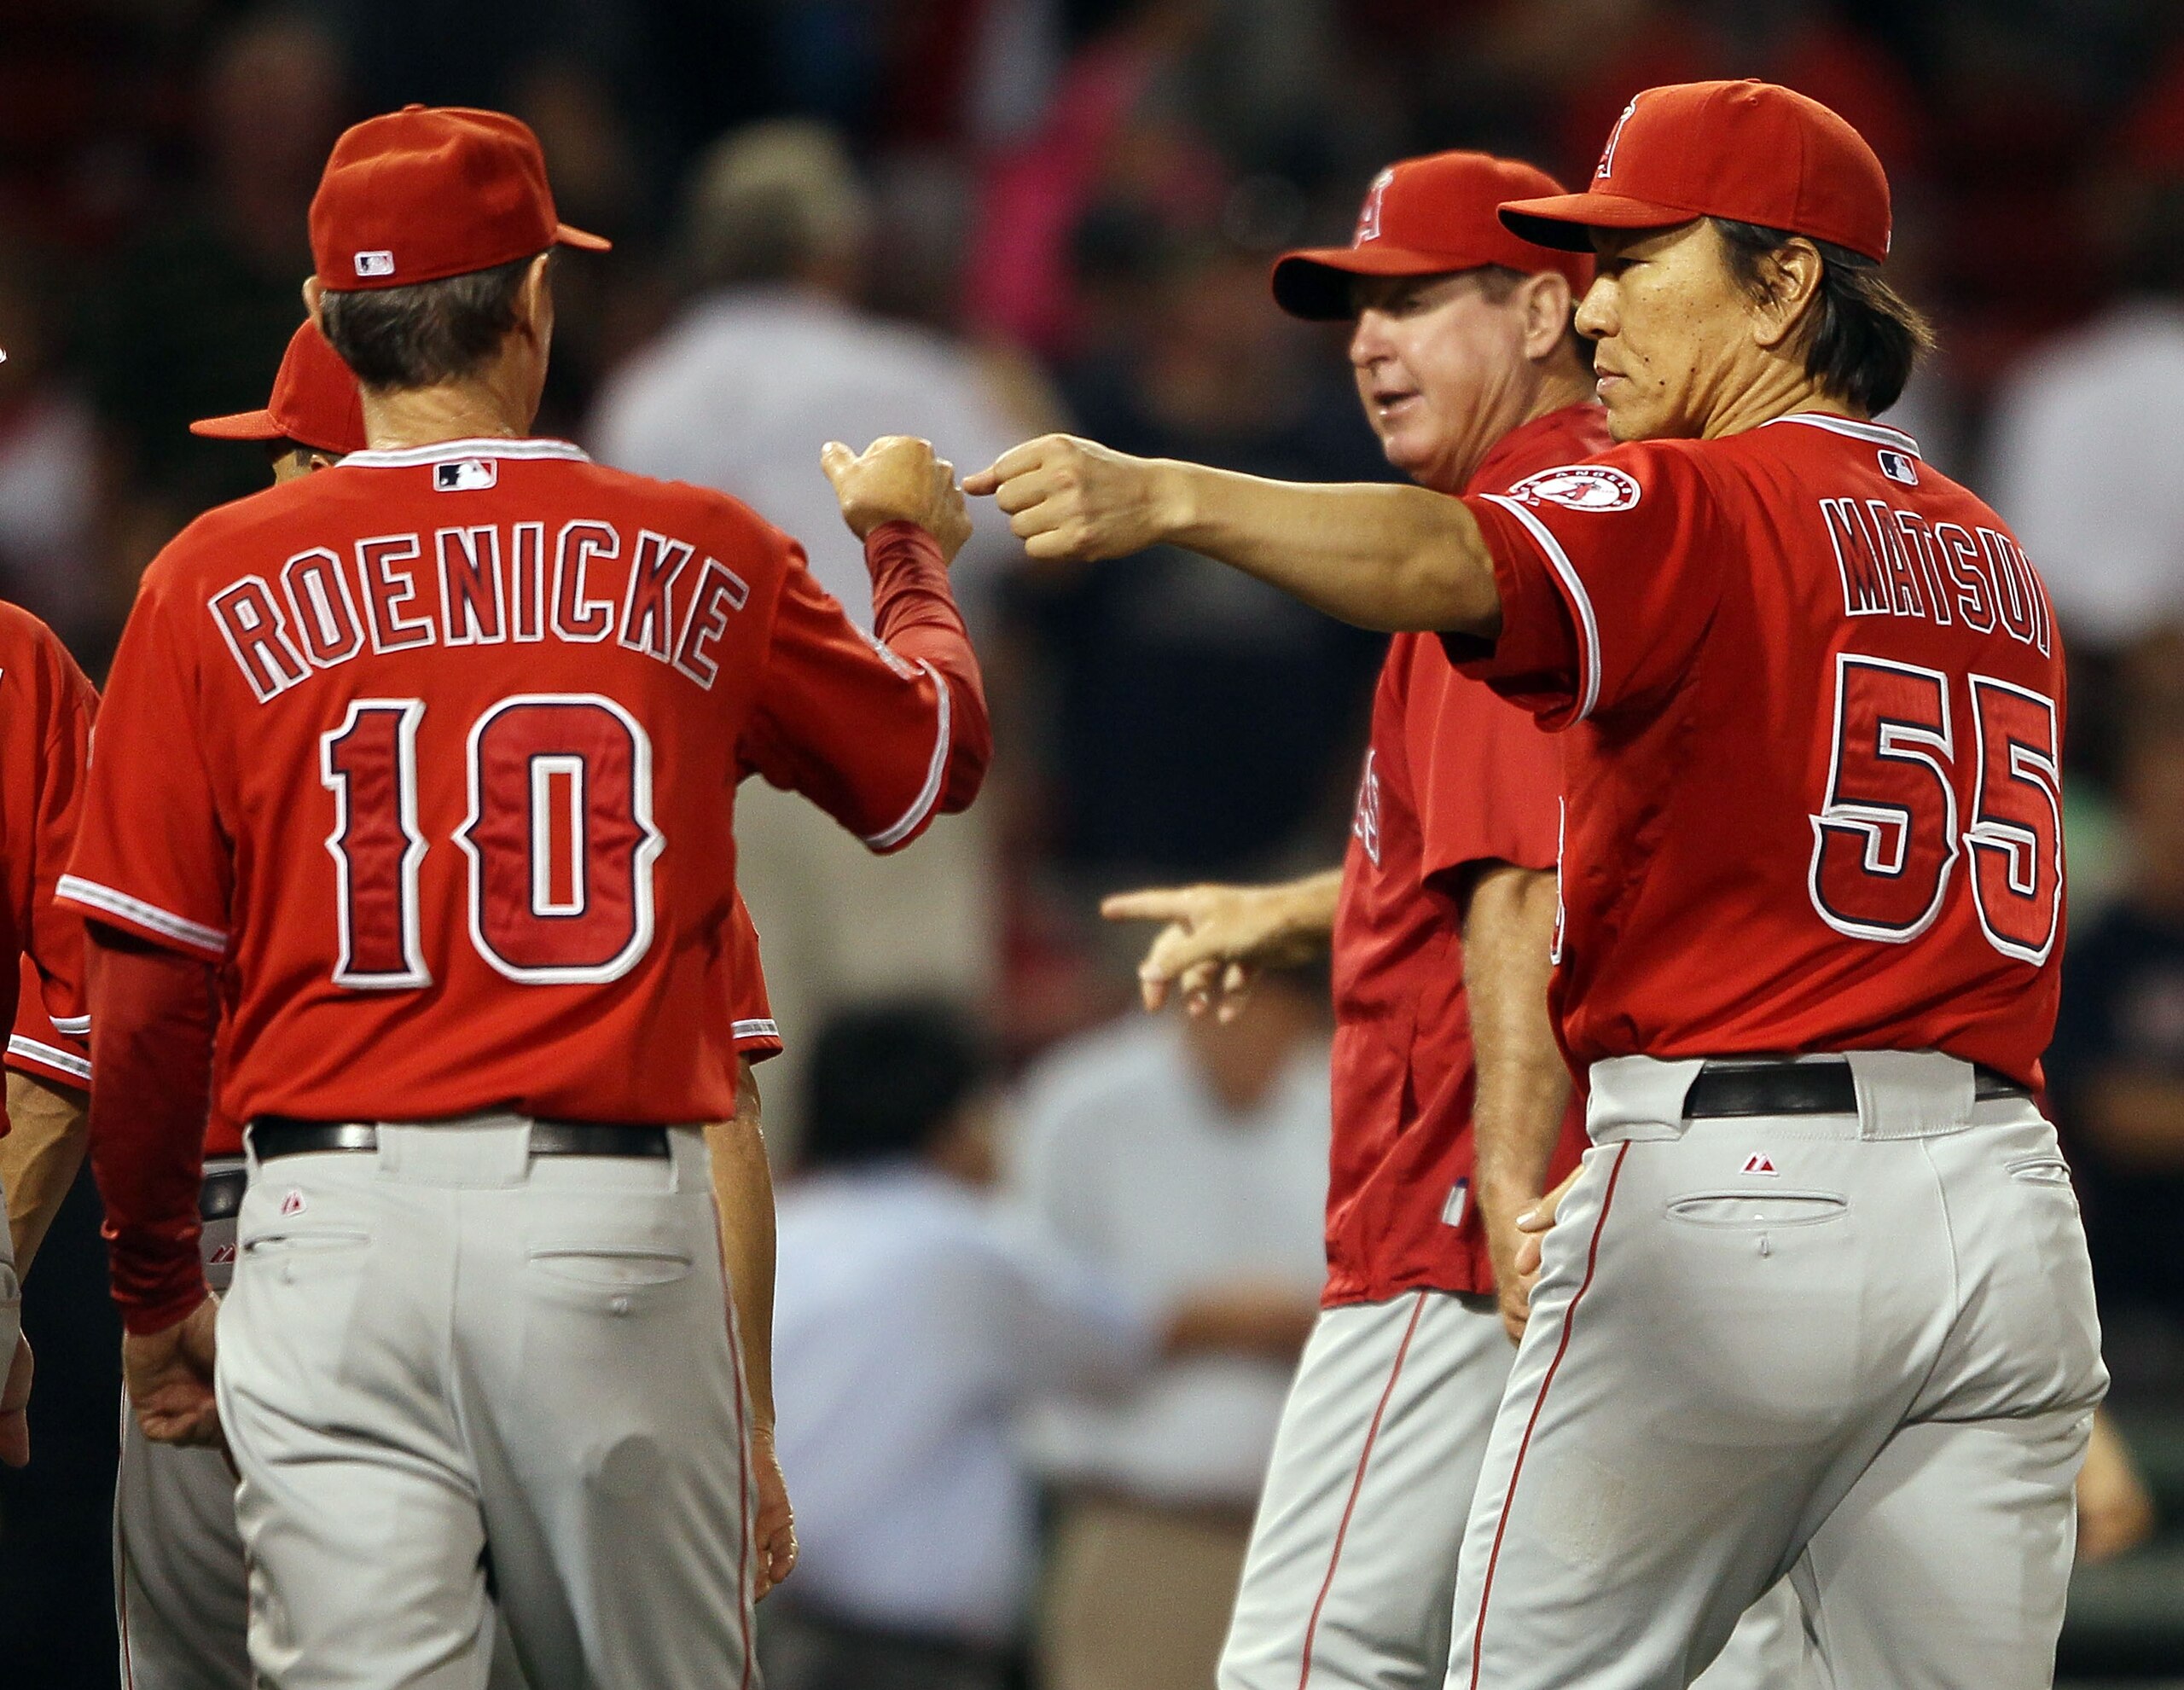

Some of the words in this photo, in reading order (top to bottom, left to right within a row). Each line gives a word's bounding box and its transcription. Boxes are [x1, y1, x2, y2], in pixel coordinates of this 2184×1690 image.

[207, 519, 750, 704] ROENICKE
[1819, 497, 2051, 659] MATSUI
[319, 692, 667, 990] 10
[1808, 652, 2063, 967] 55
